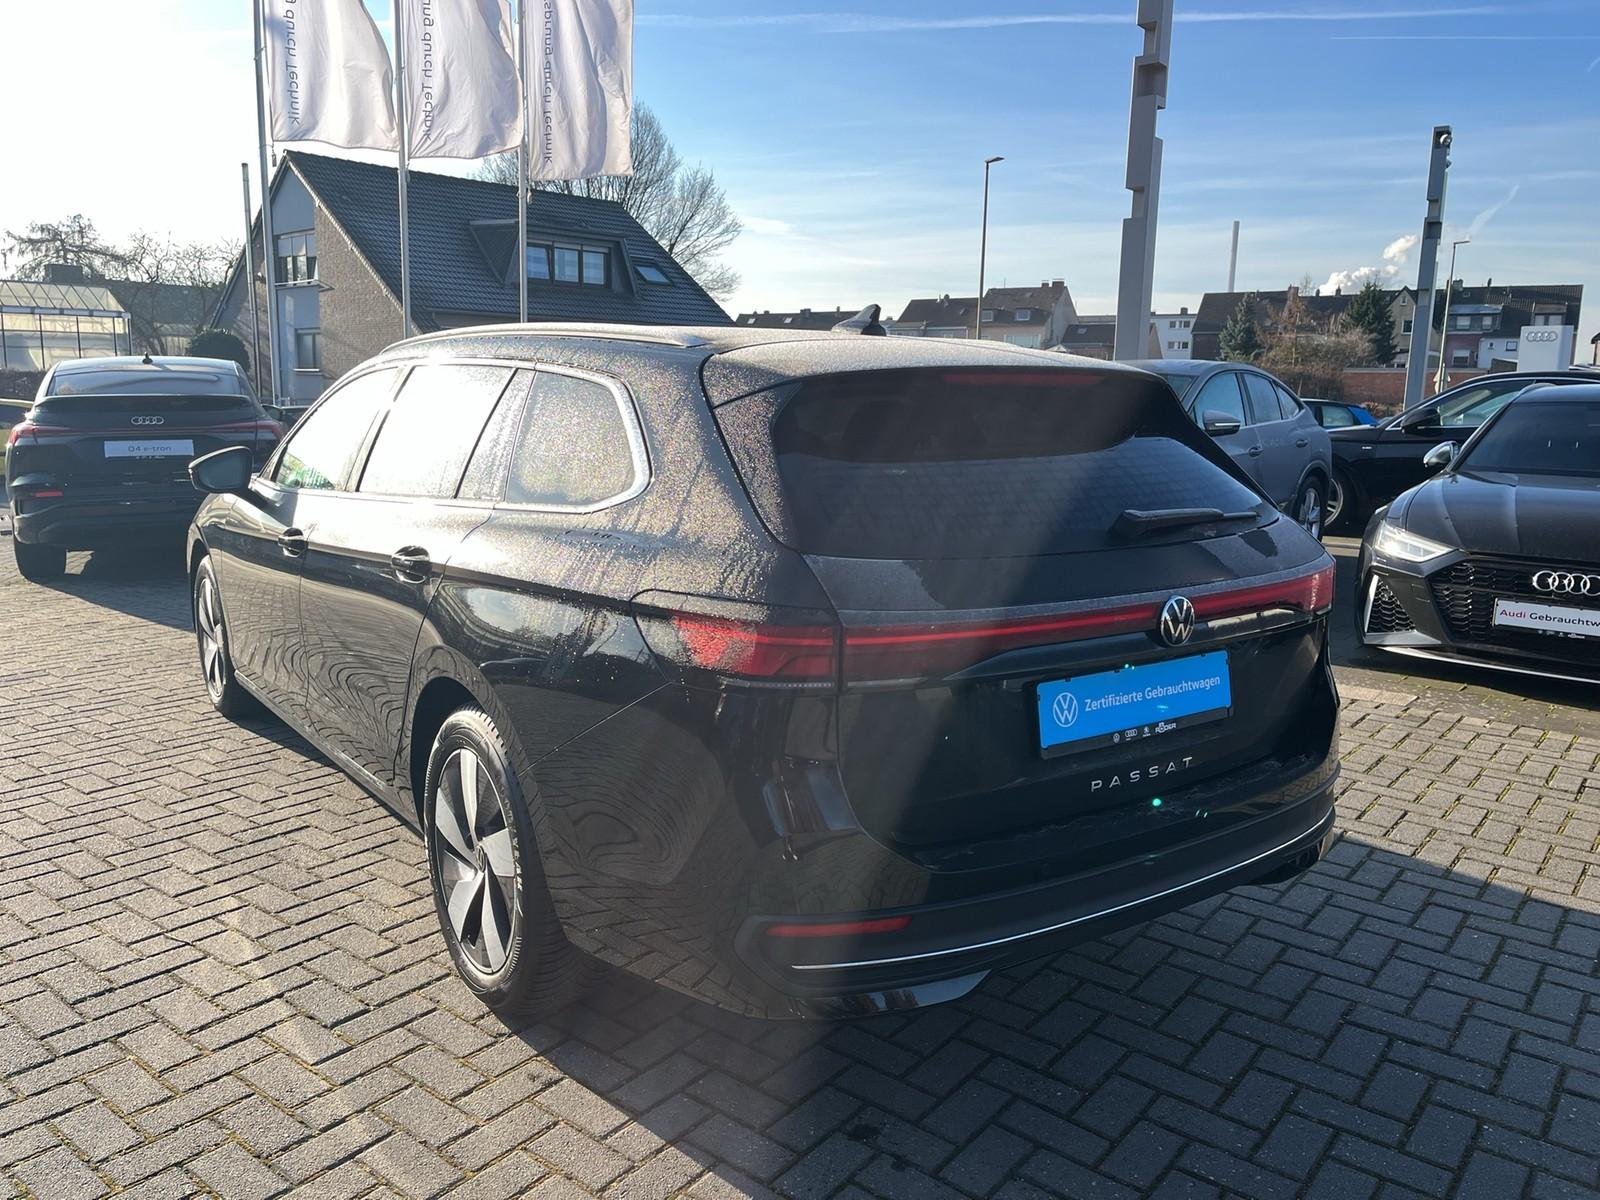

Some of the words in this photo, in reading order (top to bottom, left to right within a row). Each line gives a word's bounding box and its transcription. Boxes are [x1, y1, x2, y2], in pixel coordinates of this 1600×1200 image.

[1499, 609, 1526, 619] Audi
[1084, 692, 1144, 712] Zertifizierte
[1144, 675, 1221, 701] Gebrauchtwagen
[1091, 756, 1193, 792] PASSAT
